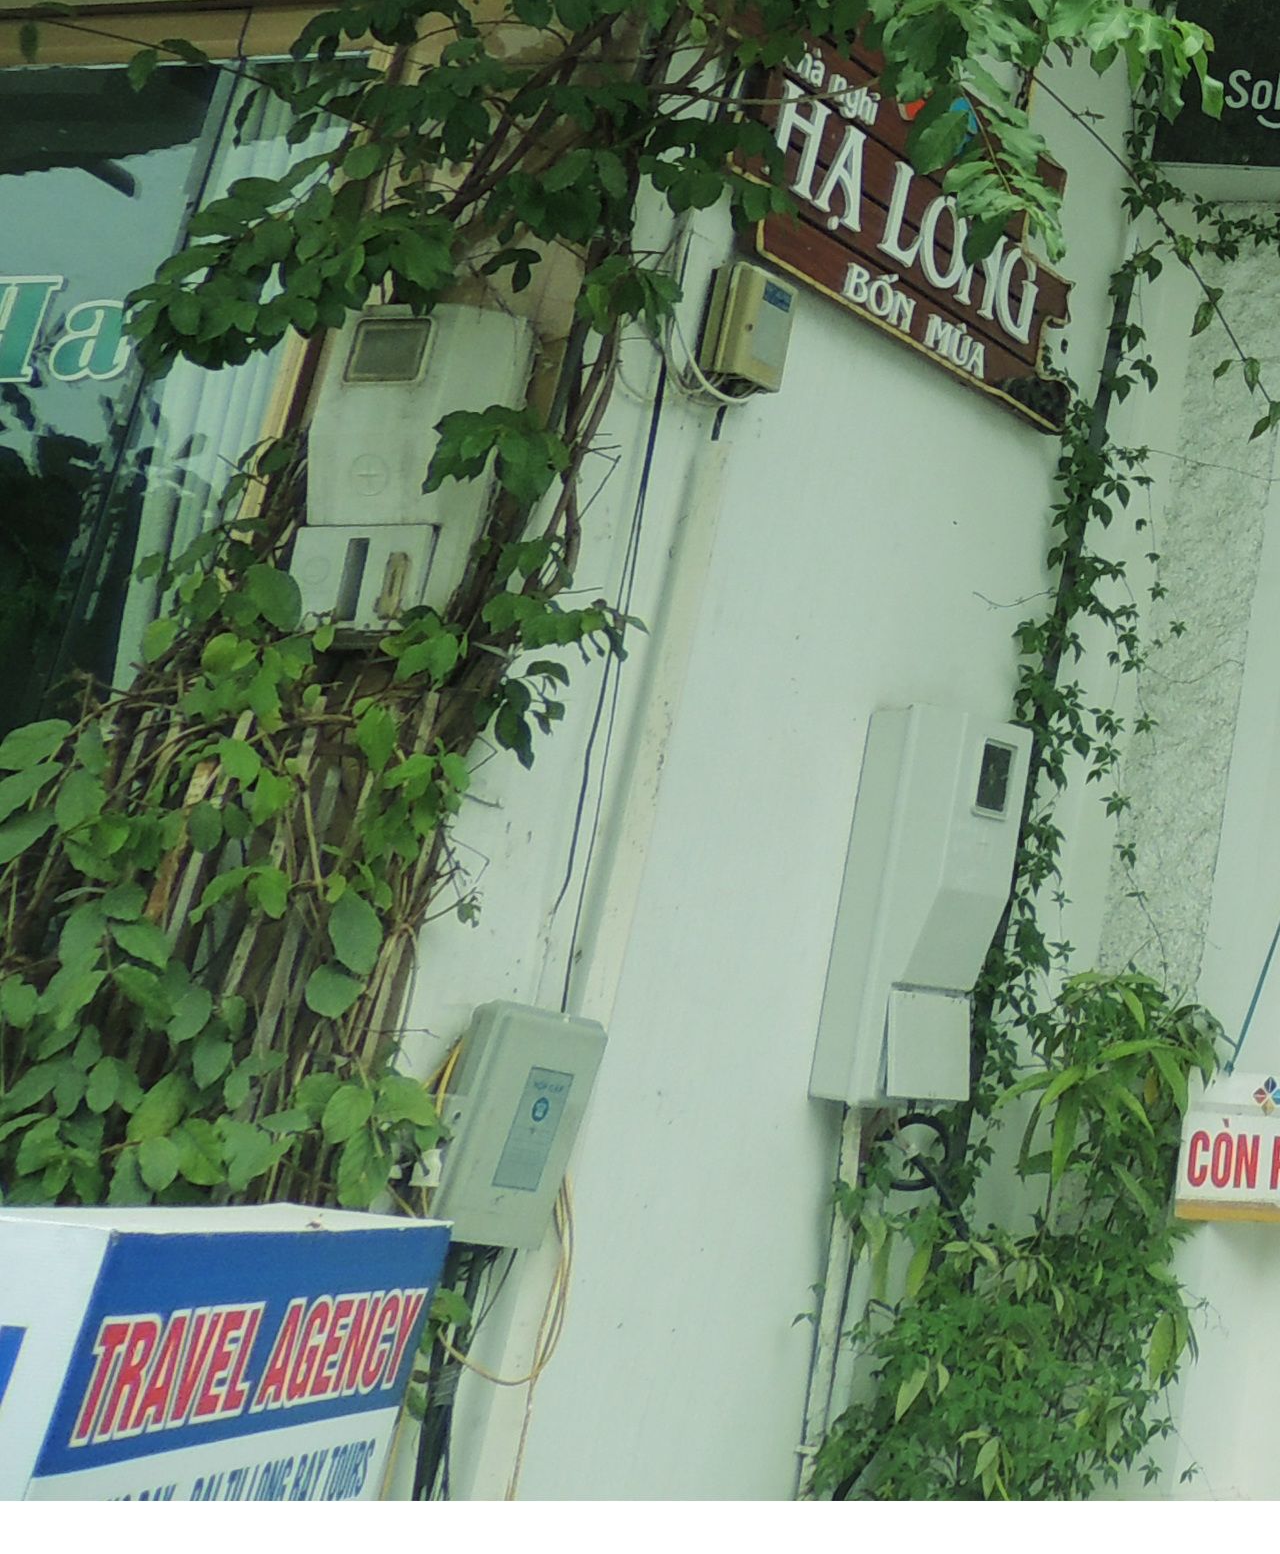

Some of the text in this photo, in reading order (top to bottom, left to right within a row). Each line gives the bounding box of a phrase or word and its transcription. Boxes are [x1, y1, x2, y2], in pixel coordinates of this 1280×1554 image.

[1187, 1118, 1261, 1190] CÒN
[70, 1288, 428, 1447] TRAVEL AGENCY
